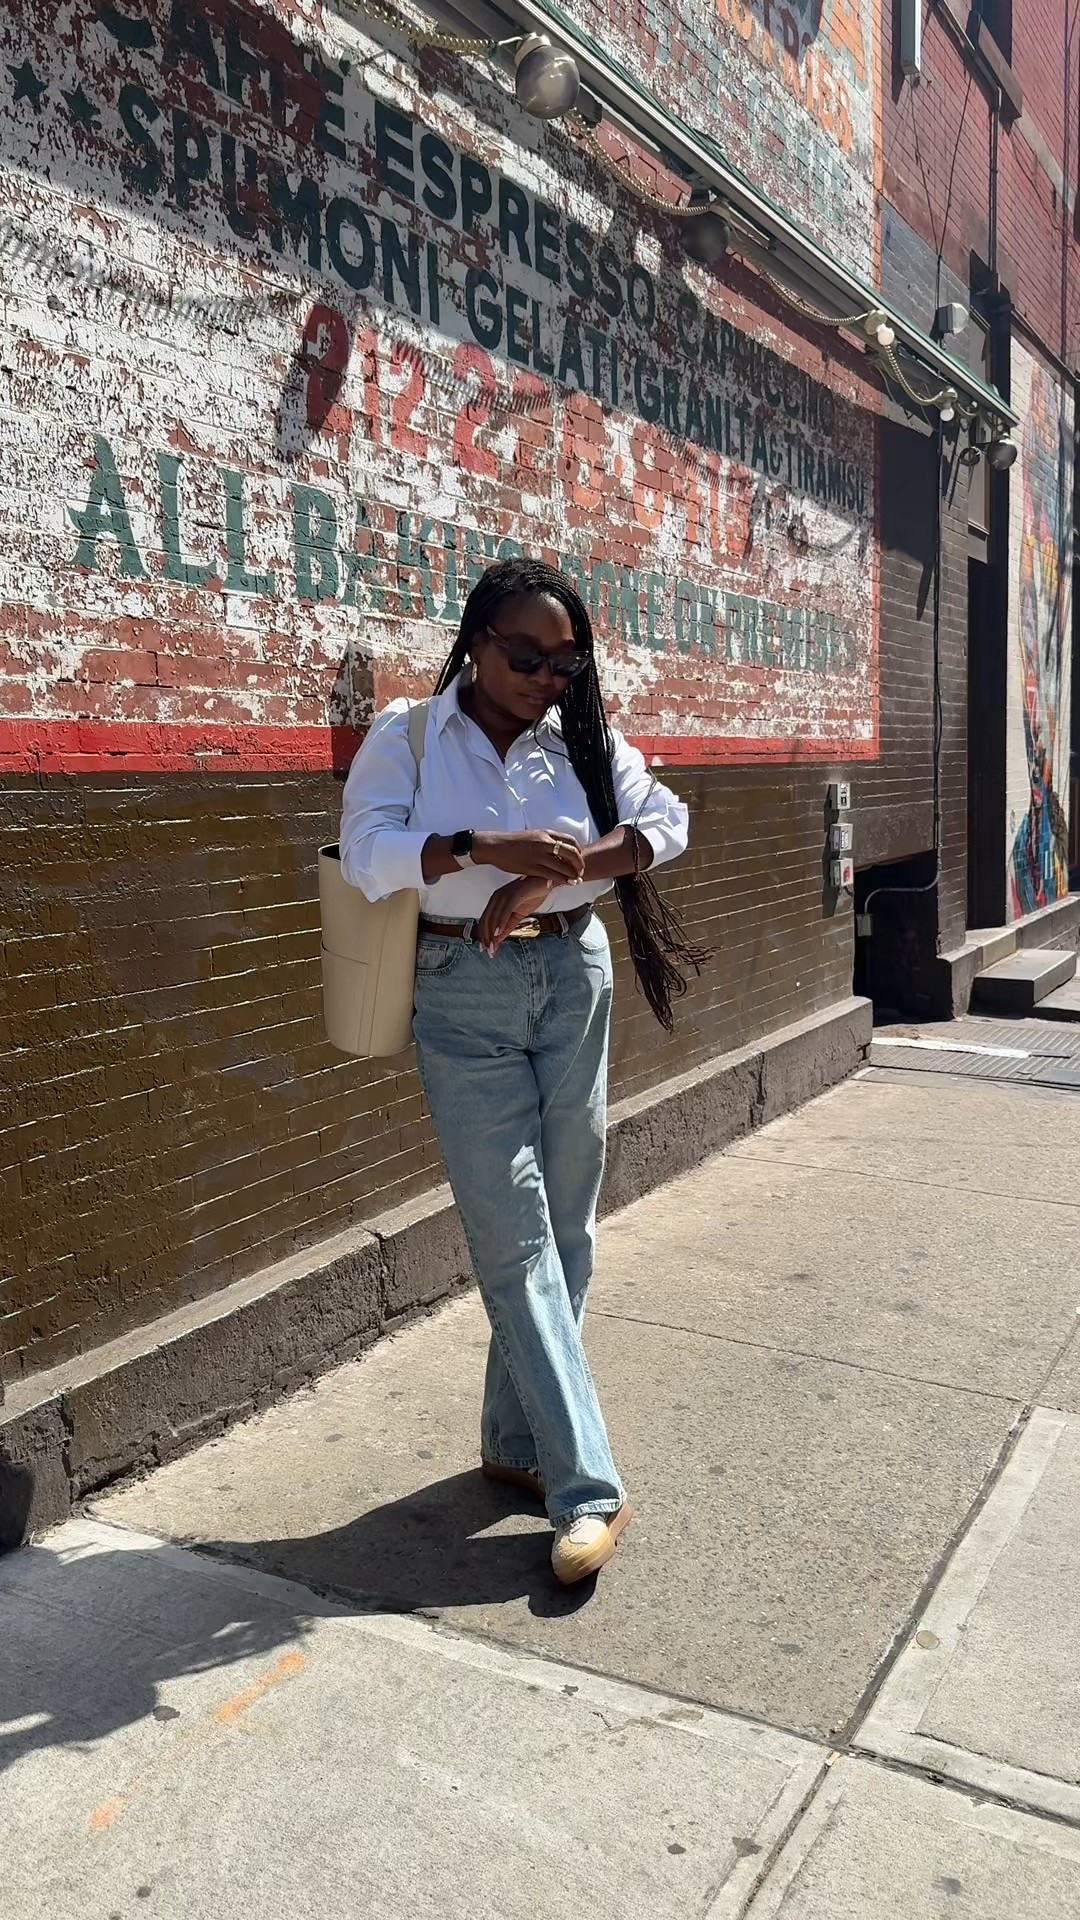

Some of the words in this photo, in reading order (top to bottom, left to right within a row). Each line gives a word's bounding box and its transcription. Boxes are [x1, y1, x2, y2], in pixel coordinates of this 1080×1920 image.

[117, 85, 441, 326] SPUMONI
[465, 267, 618, 407] GELATI
[633, 352, 769, 475] GRANITA
[784, 430, 866, 515] TIRAMISU
[375, 102, 655, 331] ESPRESSO
[302, 304, 428, 461] 212
[66, 433, 276, 597] ALL
